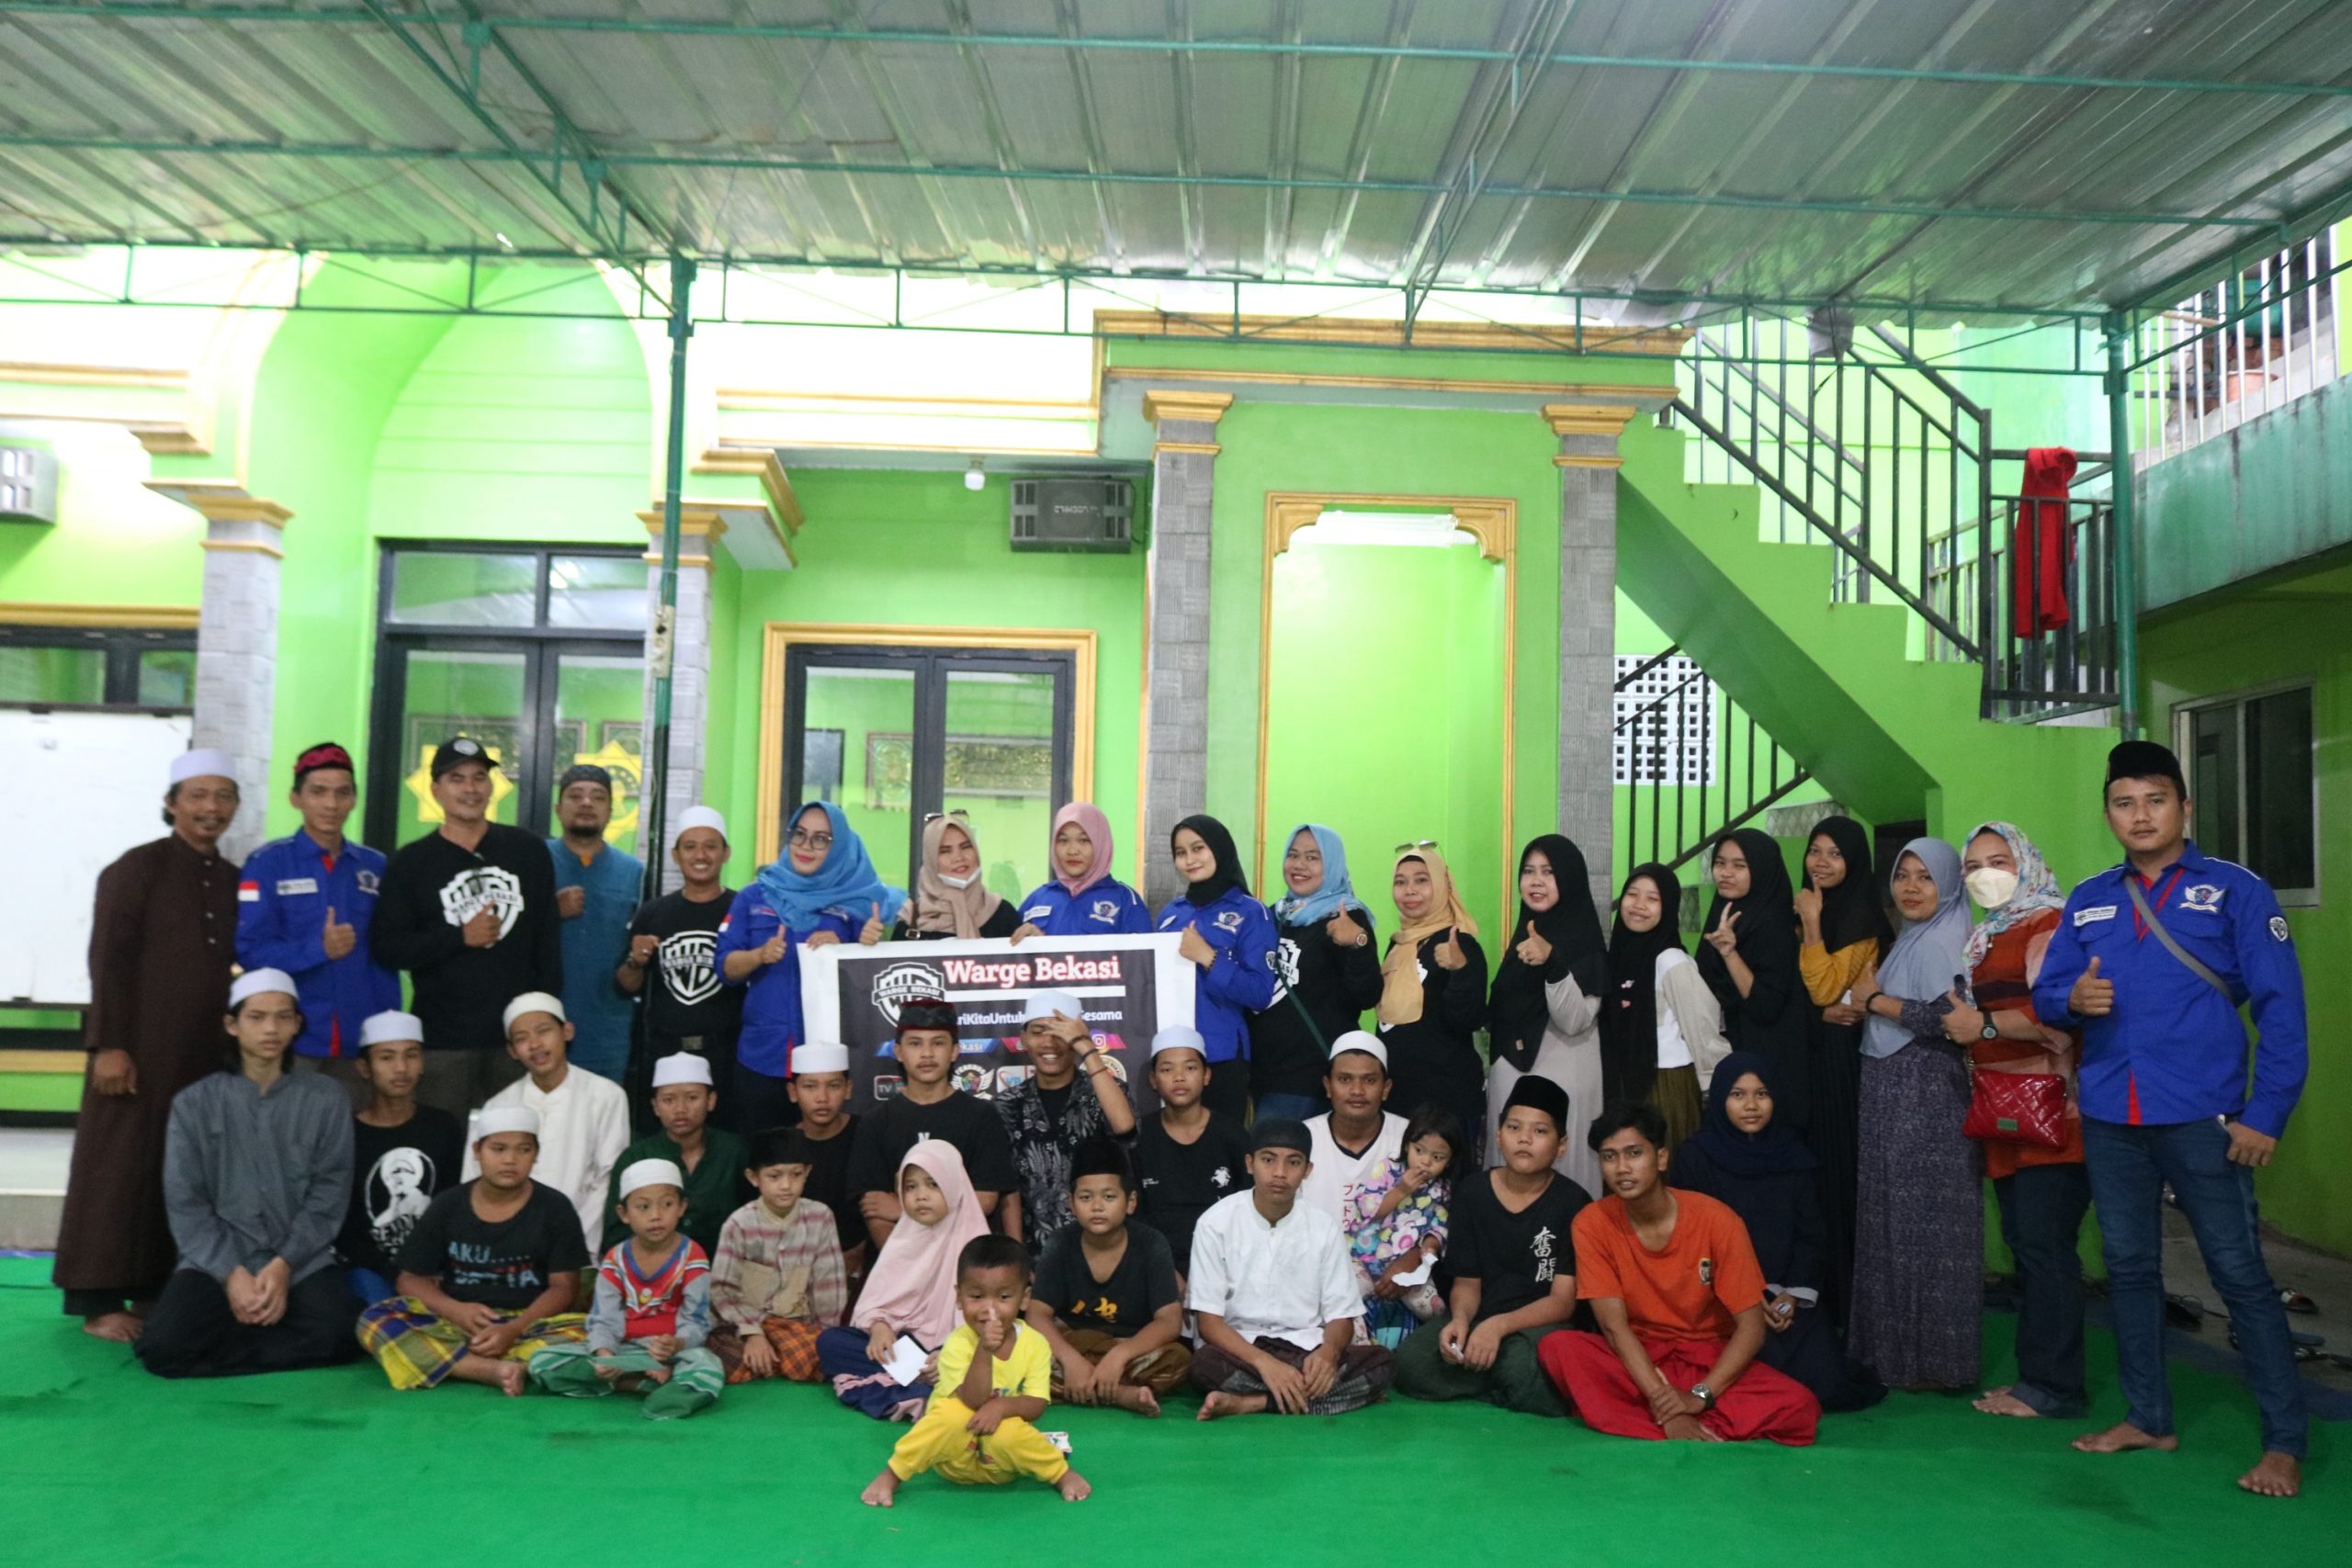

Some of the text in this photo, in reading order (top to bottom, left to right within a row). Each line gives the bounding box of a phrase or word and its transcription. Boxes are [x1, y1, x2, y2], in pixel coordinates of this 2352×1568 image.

[942, 954, 1121, 988] Warge Bekasi
[956, 1010, 1026, 1026] riKitaUntuk
